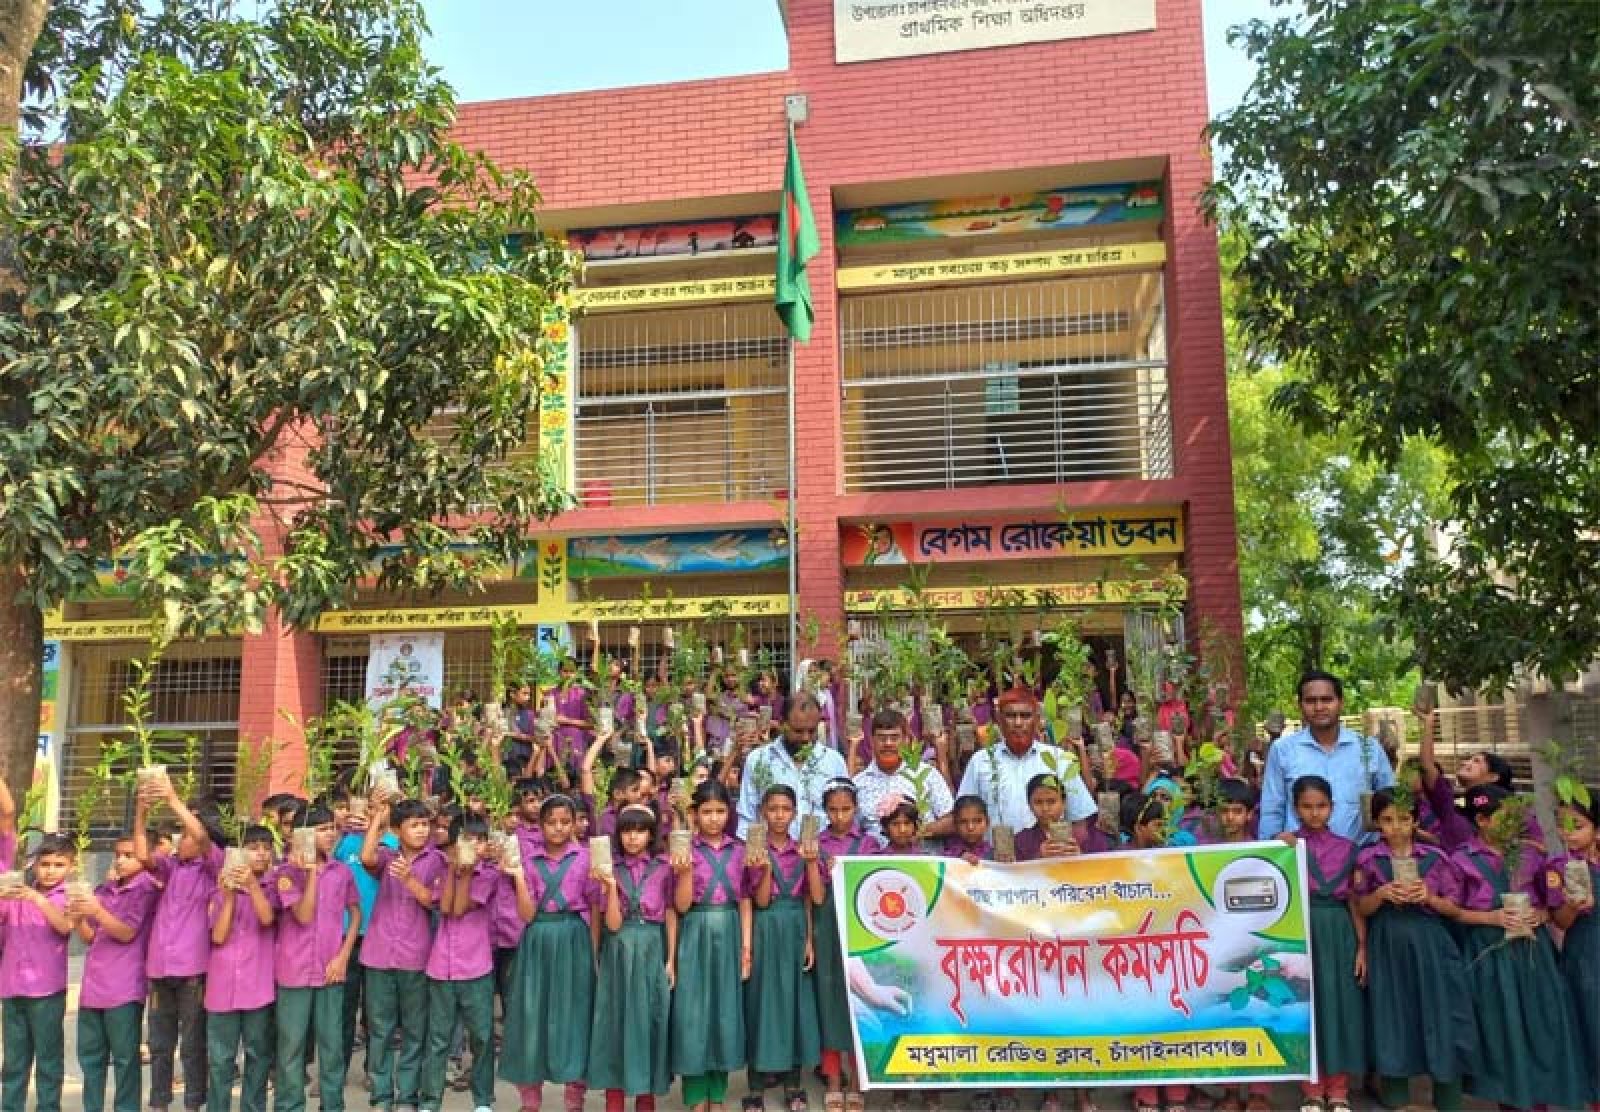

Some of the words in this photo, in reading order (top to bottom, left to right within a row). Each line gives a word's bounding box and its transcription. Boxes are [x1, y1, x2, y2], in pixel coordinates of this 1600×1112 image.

[900, 15, 964, 38] প্রাথমিক
[972, 10, 1012, 30] শিক্ষা
[1020, 4, 1085, 23] অধিদপ্তর
[919, 522, 993, 556] বেগম
[1000, 516, 1107, 552] রোকেয়া
[1110, 516, 1178, 548] ভবন
[1049, 884, 1107, 904] পরিবেশ
[936, 932, 1090, 1026] বৃক্ষরোপন
[1097, 909, 1212, 1016] কর্মসূচি
[907, 1044, 978, 1073] মধুমালা
[986, 1041, 1047, 1064] রেডিও
[1055, 1044, 1101, 1067] ক্লাব,
[1109, 1038, 1247, 1066] চাঁপাইনবাবগঞ্জ
